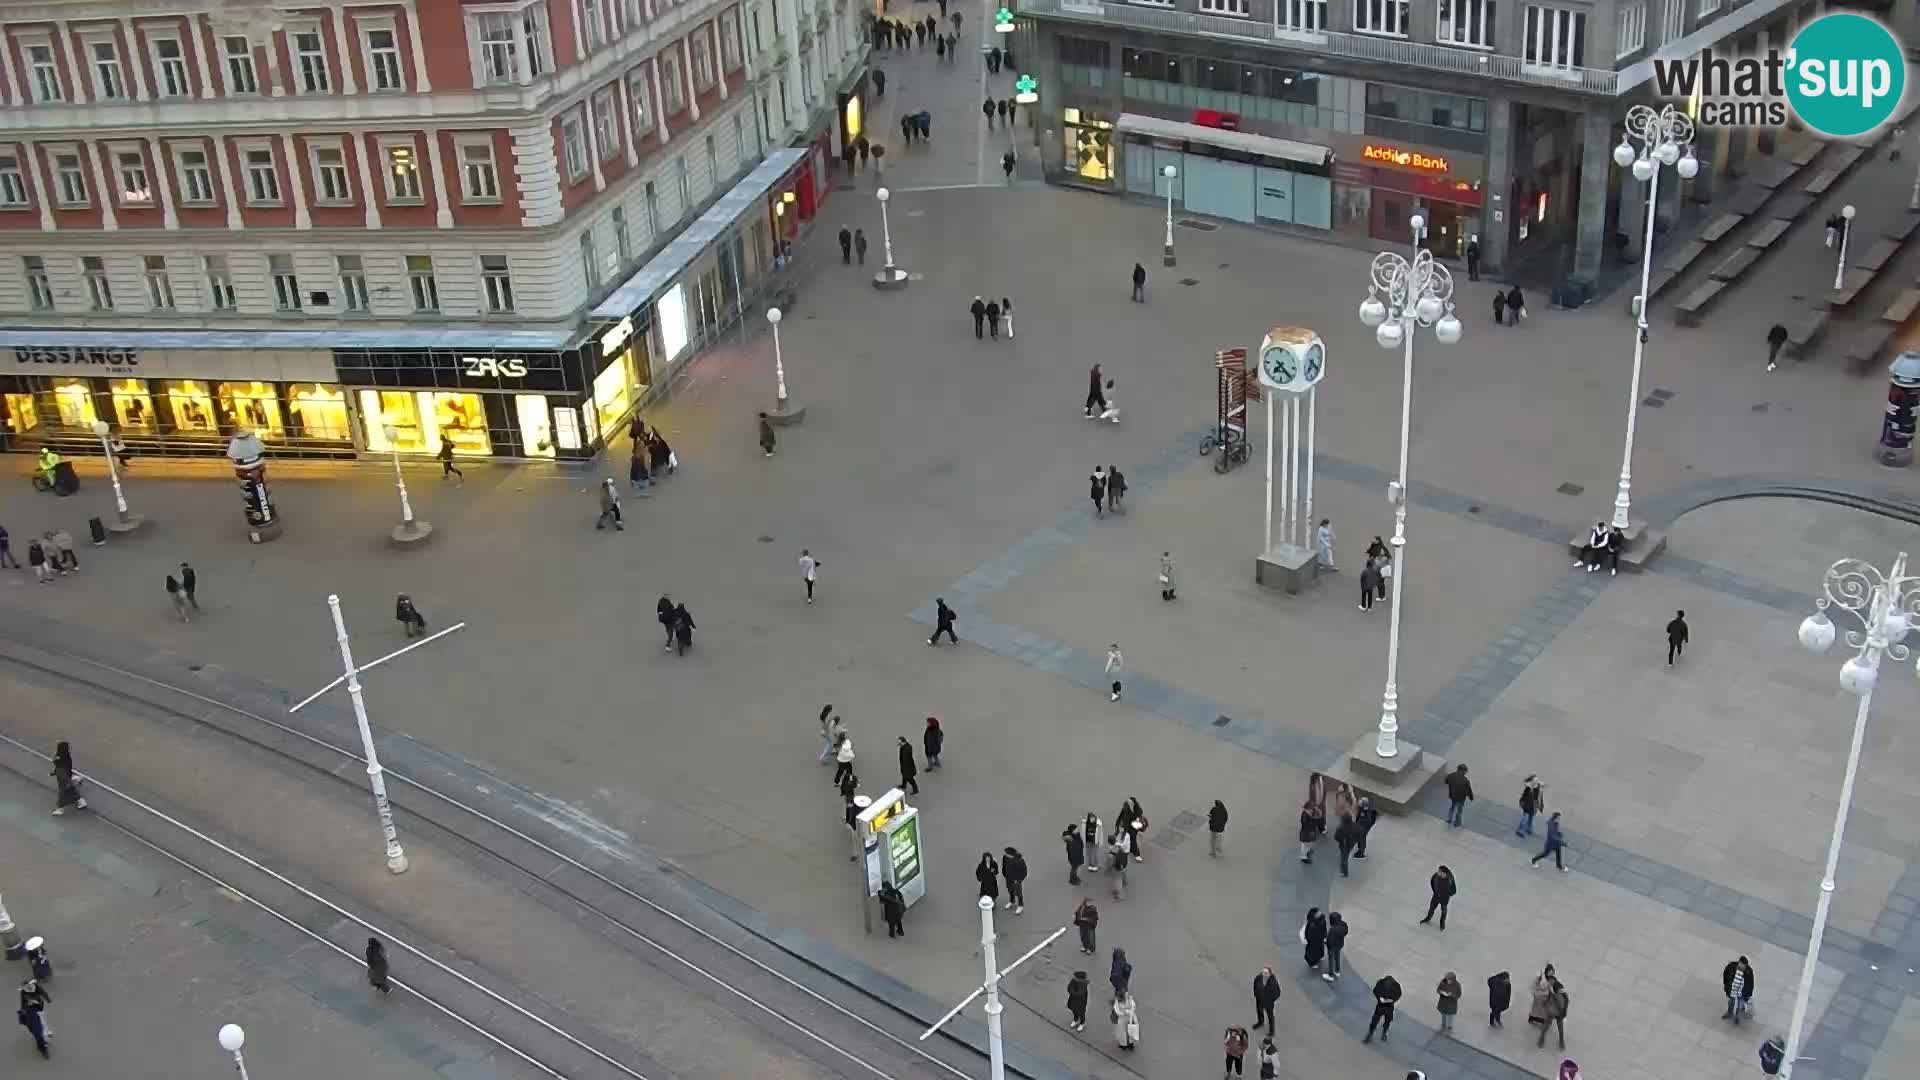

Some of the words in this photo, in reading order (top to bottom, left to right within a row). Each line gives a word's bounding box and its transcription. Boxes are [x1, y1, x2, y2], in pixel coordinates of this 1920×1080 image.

[1363, 145, 1411, 165] Addiko
[1413, 153, 1448, 172] Bank
[15, 347, 138, 366] DESSANGE
[462, 357, 528, 378] ZAKS
